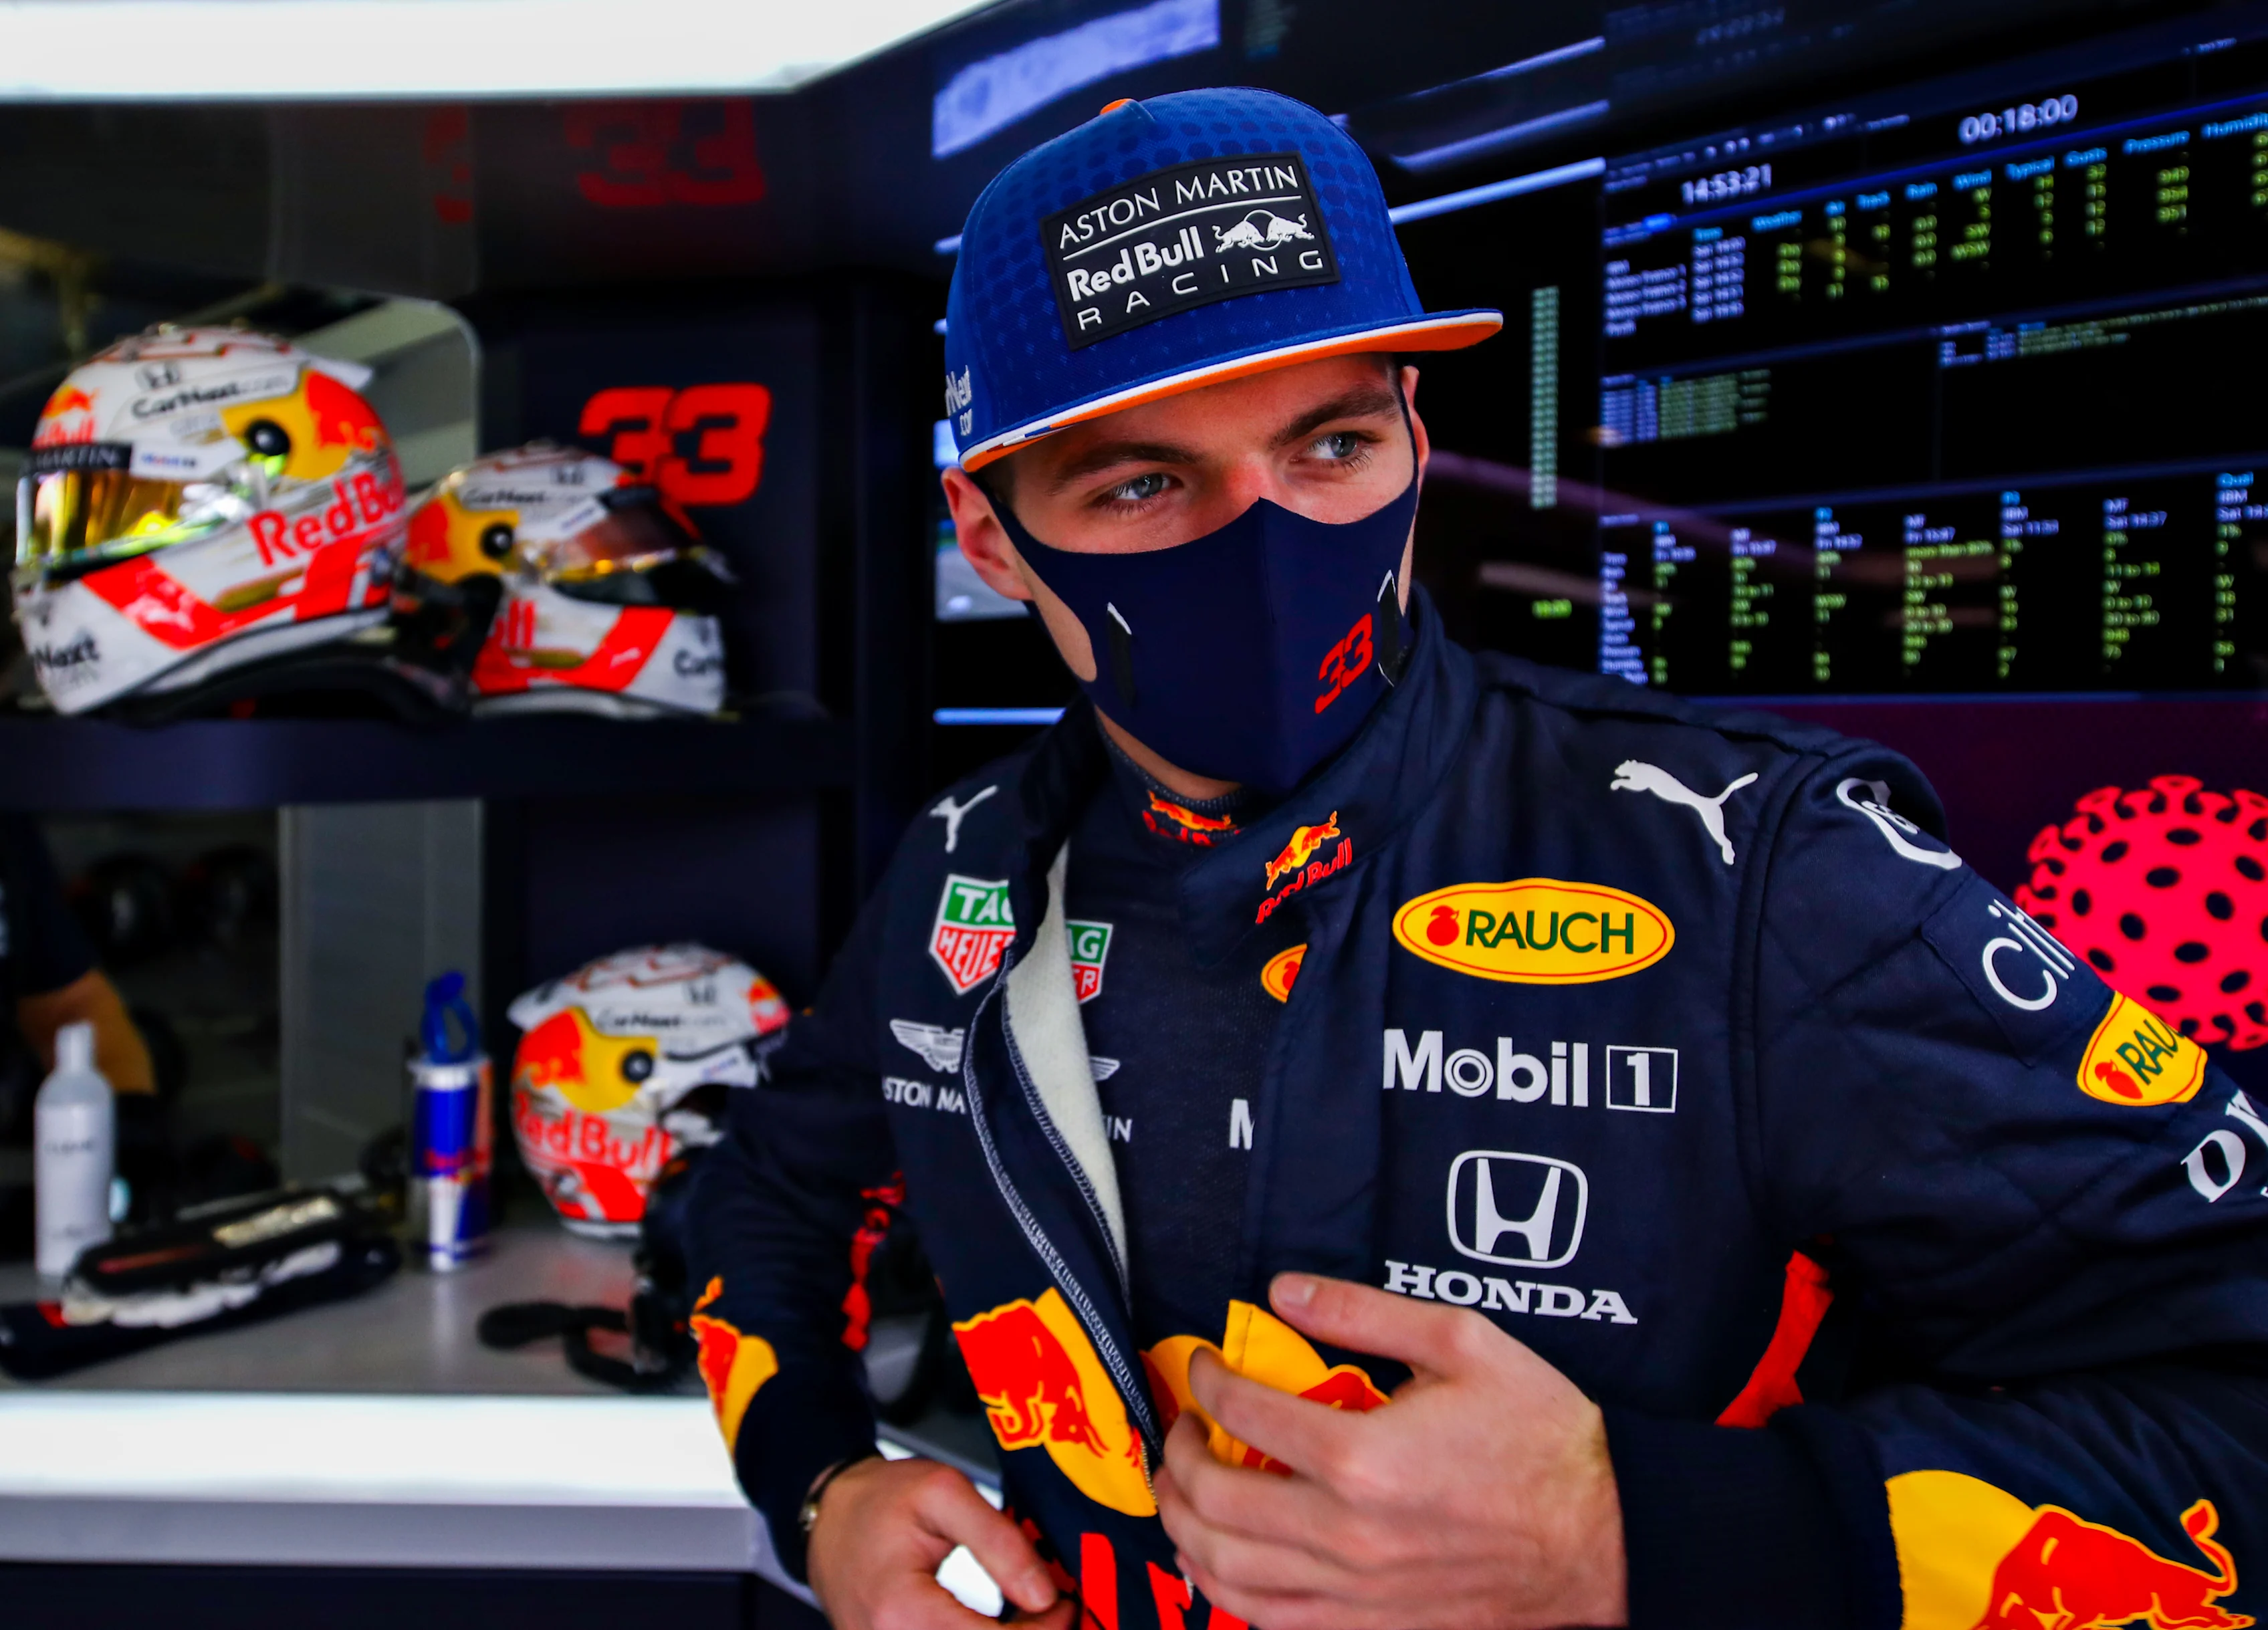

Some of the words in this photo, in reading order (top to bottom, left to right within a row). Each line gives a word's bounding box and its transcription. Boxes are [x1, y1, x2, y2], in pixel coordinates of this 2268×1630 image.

[1958, 94, 2078, 144] 00:18:00
[1059, 188, 1159, 249] ASTON
[1175, 164, 1298, 205] MARTIN
[1682, 163, 1772, 204] 14:53:21
[1076, 250, 1323, 331] RACING
[579, 382, 771, 506] 33
[1314, 612, 1373, 714] 33
[939, 929, 1016, 982] HEUE
[1465, 909, 1635, 954] RAUCH
[1982, 898, 2076, 1011] cit
[1382, 1028, 1589, 1108] Mobil
[1627, 1052, 1653, 1107] 1
[2116, 1018, 2186, 1086] RAU
[882, 1076, 932, 1109] STON
[936, 1090, 967, 1115] MA
[1383, 1258, 1638, 1326] HONDA
